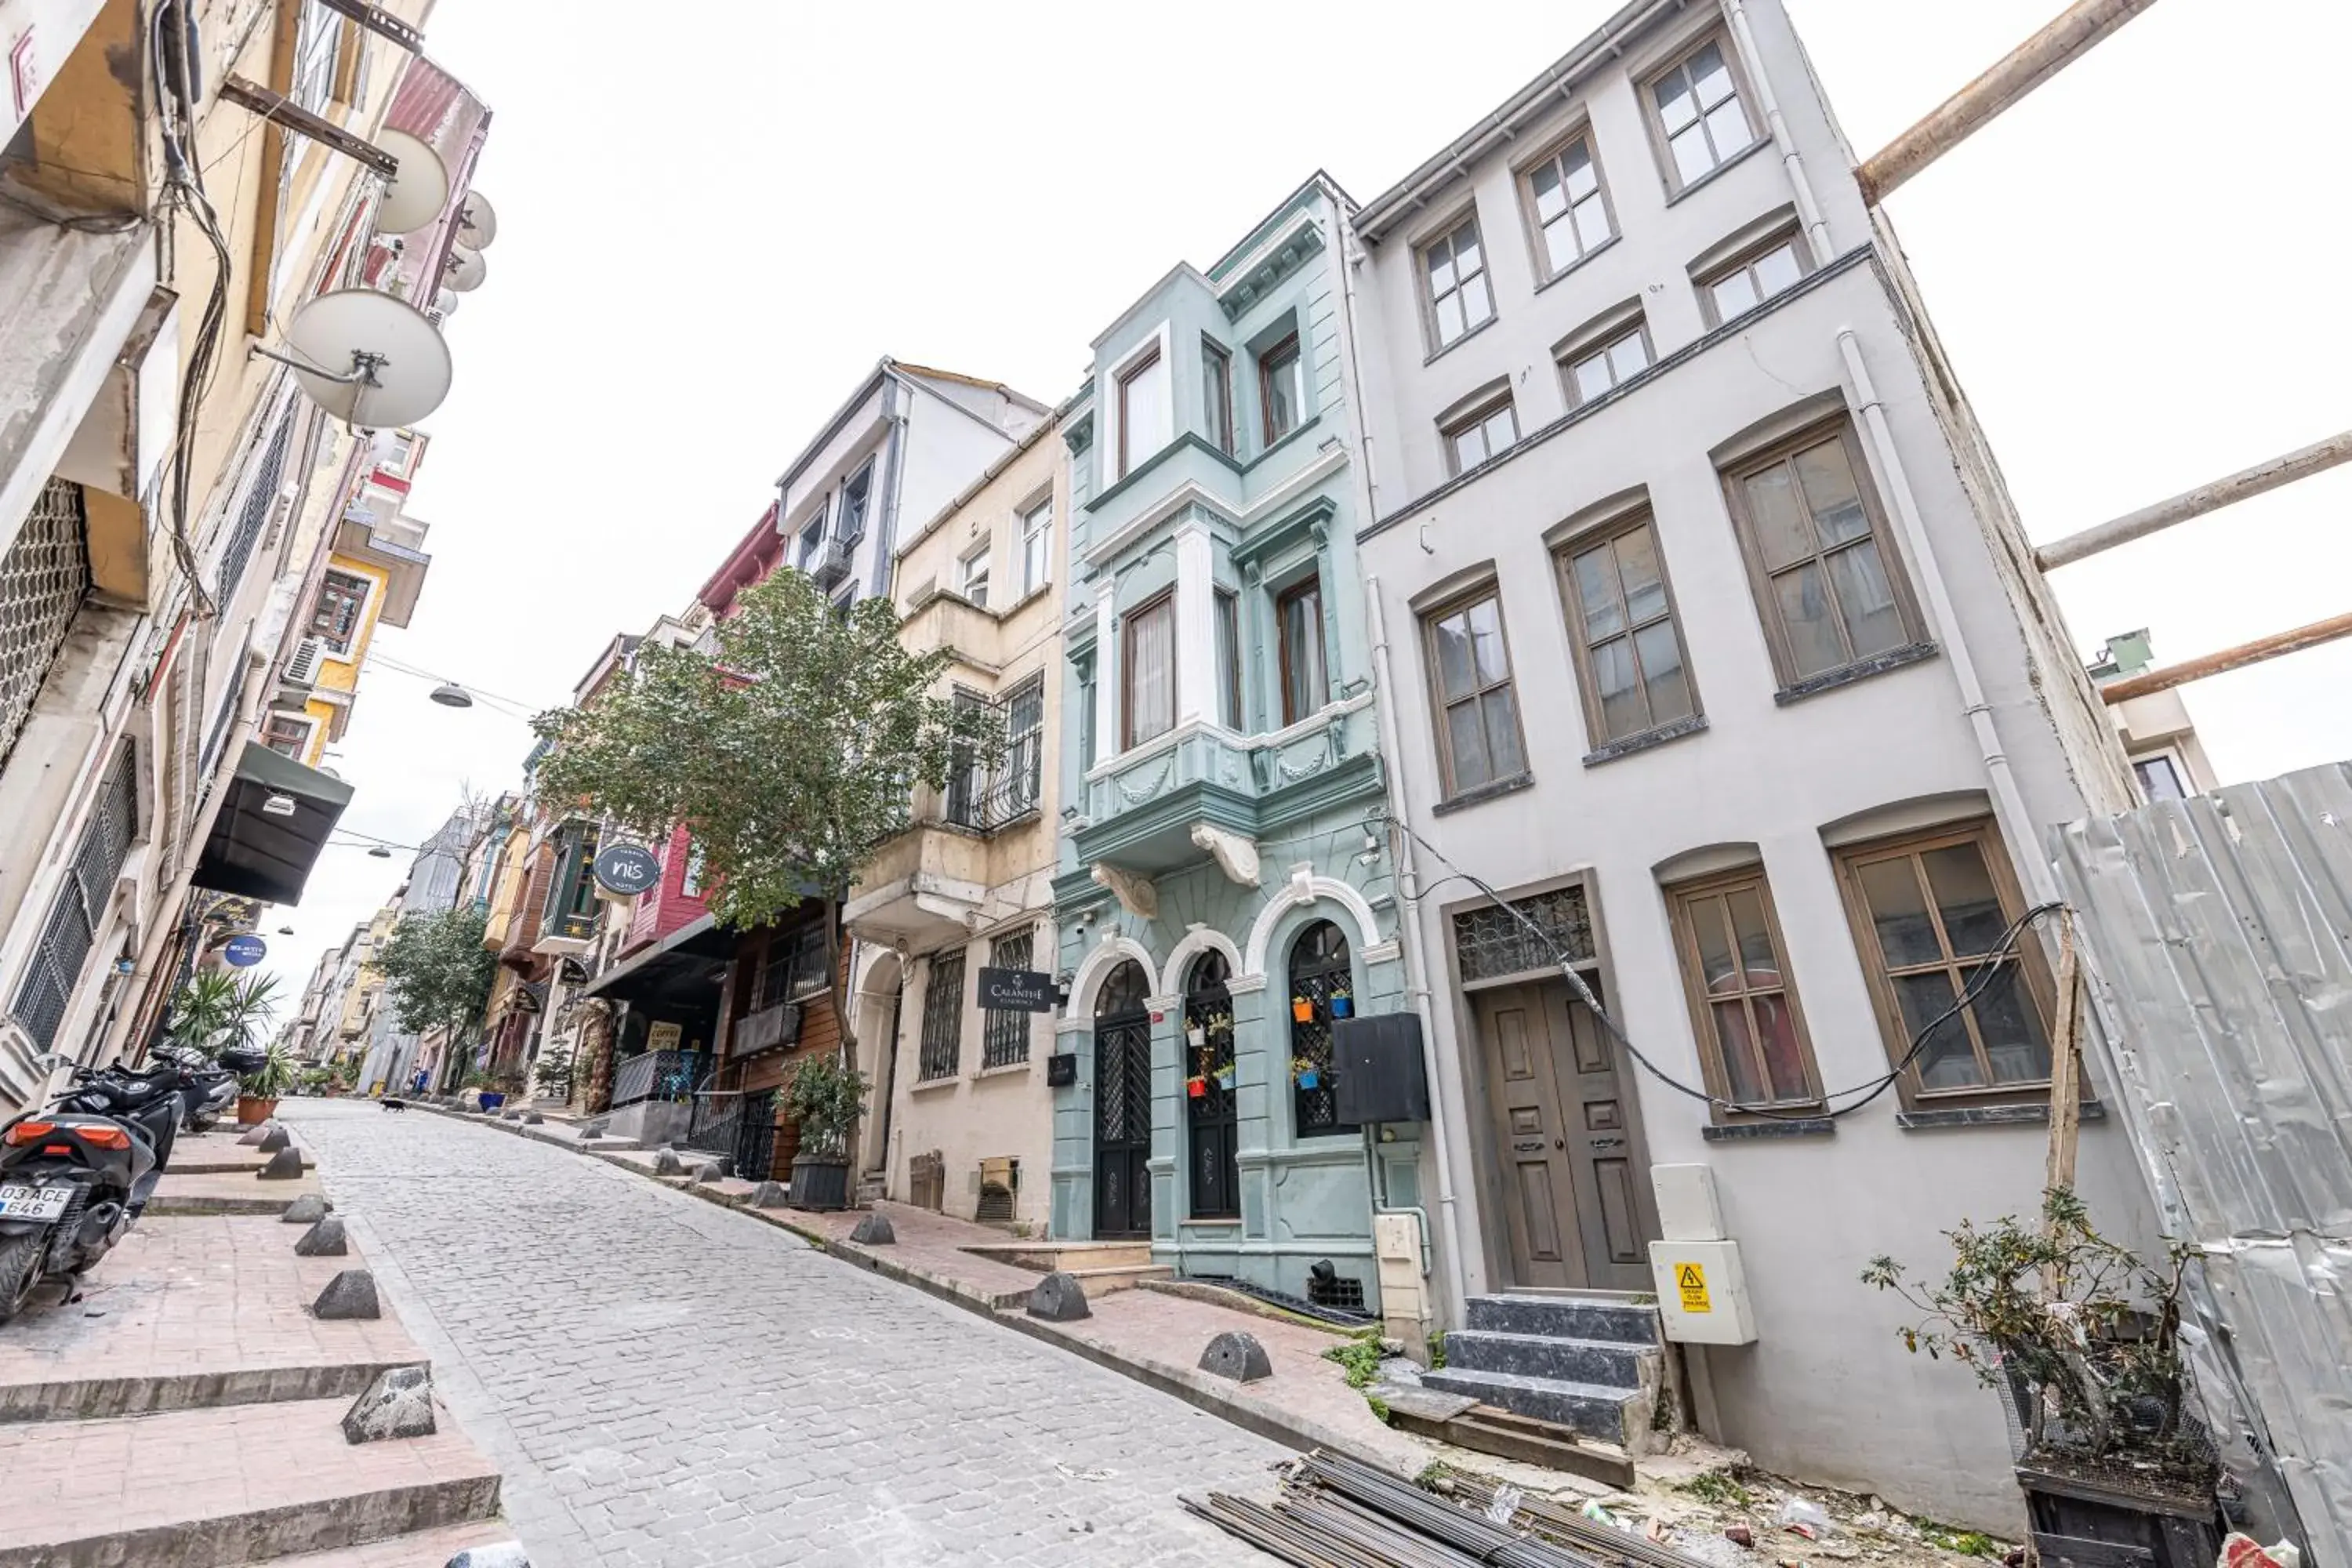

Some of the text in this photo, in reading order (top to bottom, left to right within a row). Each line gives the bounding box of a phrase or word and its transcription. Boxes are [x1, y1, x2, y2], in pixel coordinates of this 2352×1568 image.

[612, 861, 643, 879] nis
[2, 1188, 67, 1202] 03 ACE
[7, 1202, 44, 1215] 646
